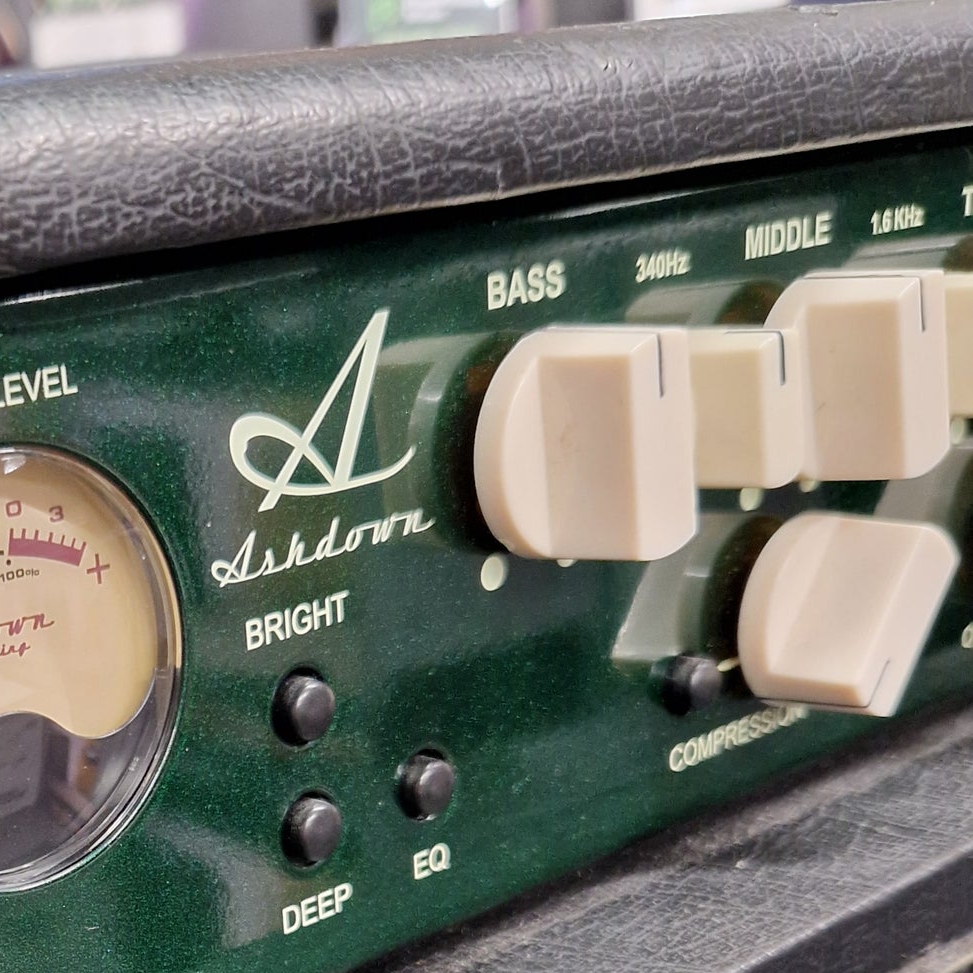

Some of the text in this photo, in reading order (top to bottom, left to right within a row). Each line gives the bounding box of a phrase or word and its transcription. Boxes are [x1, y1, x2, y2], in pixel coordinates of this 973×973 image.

[744, 210, 833, 260] MIDDLE
[893, 203, 926, 231] KHz
[487, 258, 567, 311] BASS
[635, 249, 692, 283] 340Hz
[5, 500, 22, 518] 0
[48, 504, 65, 523] 3
[211, 507, 437, 588] Ashdown
[245, 589, 350, 651] BRIGHT
[412, 842, 452, 880] EQ
[282, 882, 354, 935] DEEP
